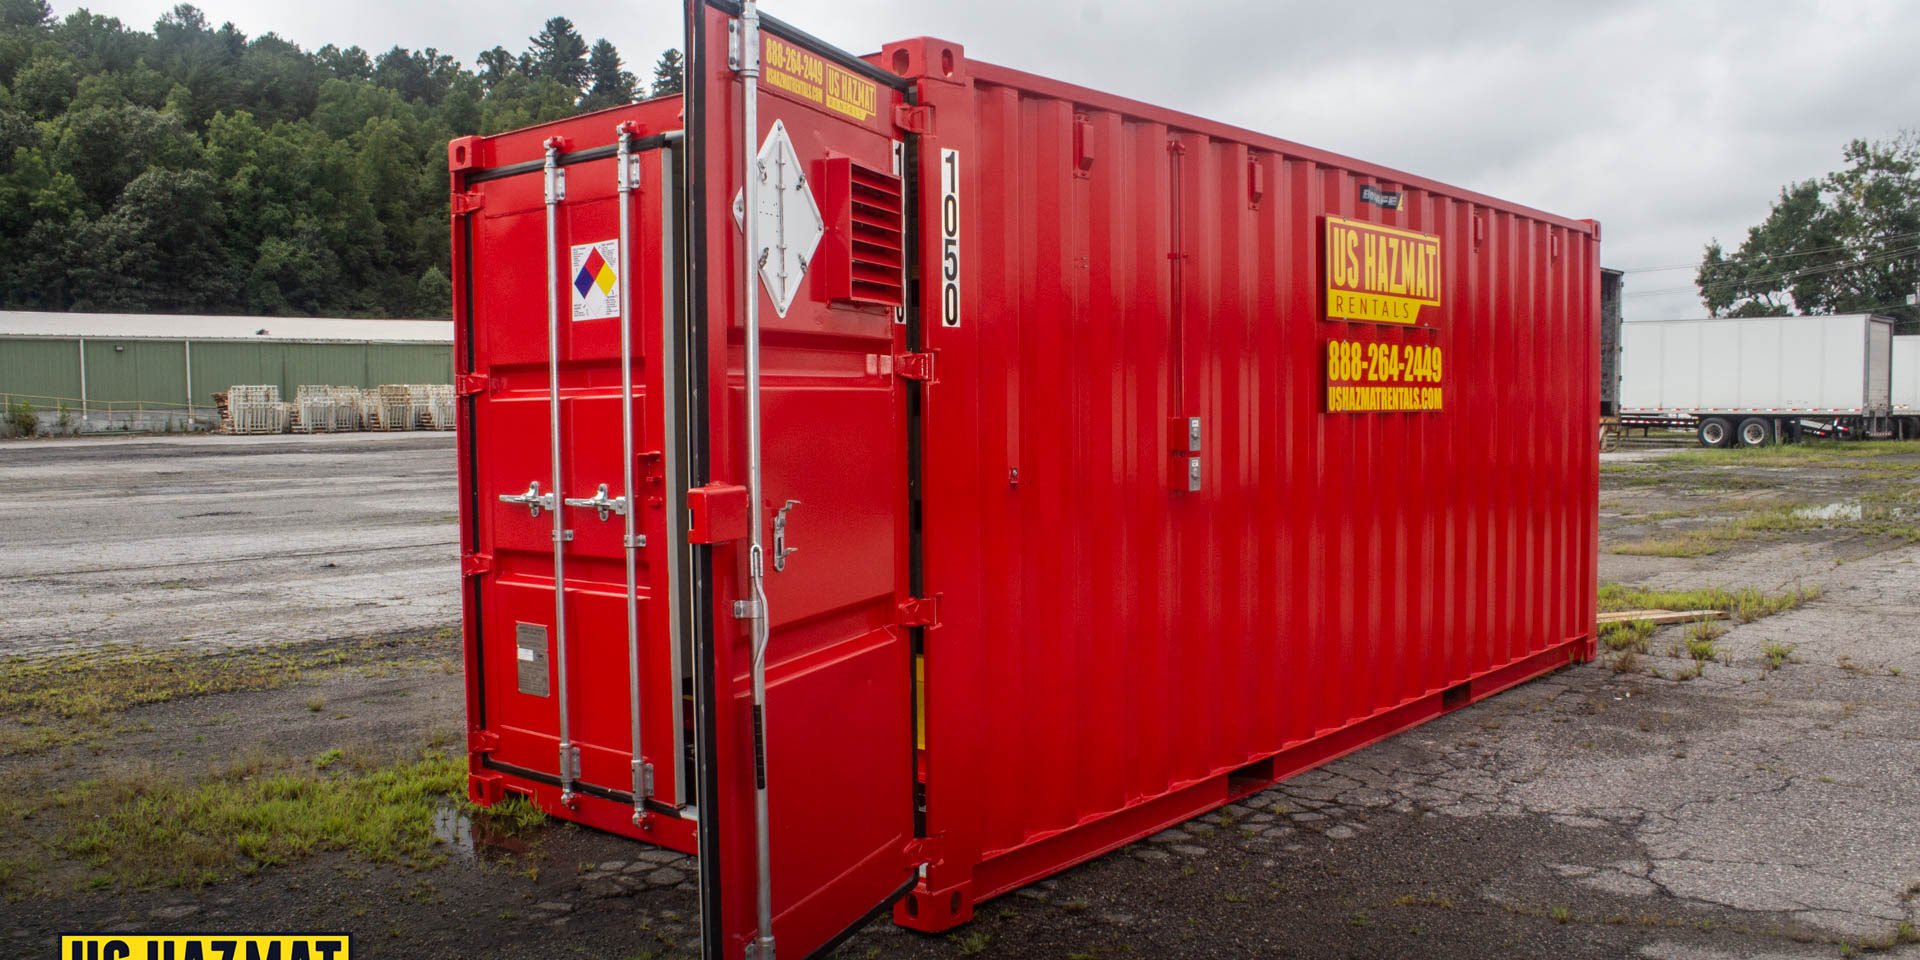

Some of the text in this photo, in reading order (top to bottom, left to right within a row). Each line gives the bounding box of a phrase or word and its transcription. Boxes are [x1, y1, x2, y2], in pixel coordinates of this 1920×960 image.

[766, 38, 823, 85] 888-264-2449
[828, 68, 875, 113] US HAZMAT
[944, 151, 958, 326] 1050
[1333, 226, 1437, 298] US HAZMAT
[1335, 295, 1410, 319] RENTALS
[1328, 340, 1442, 382] 888-264-2449
[1328, 386, 1442, 411] USHAZMATRENTALS.COM
